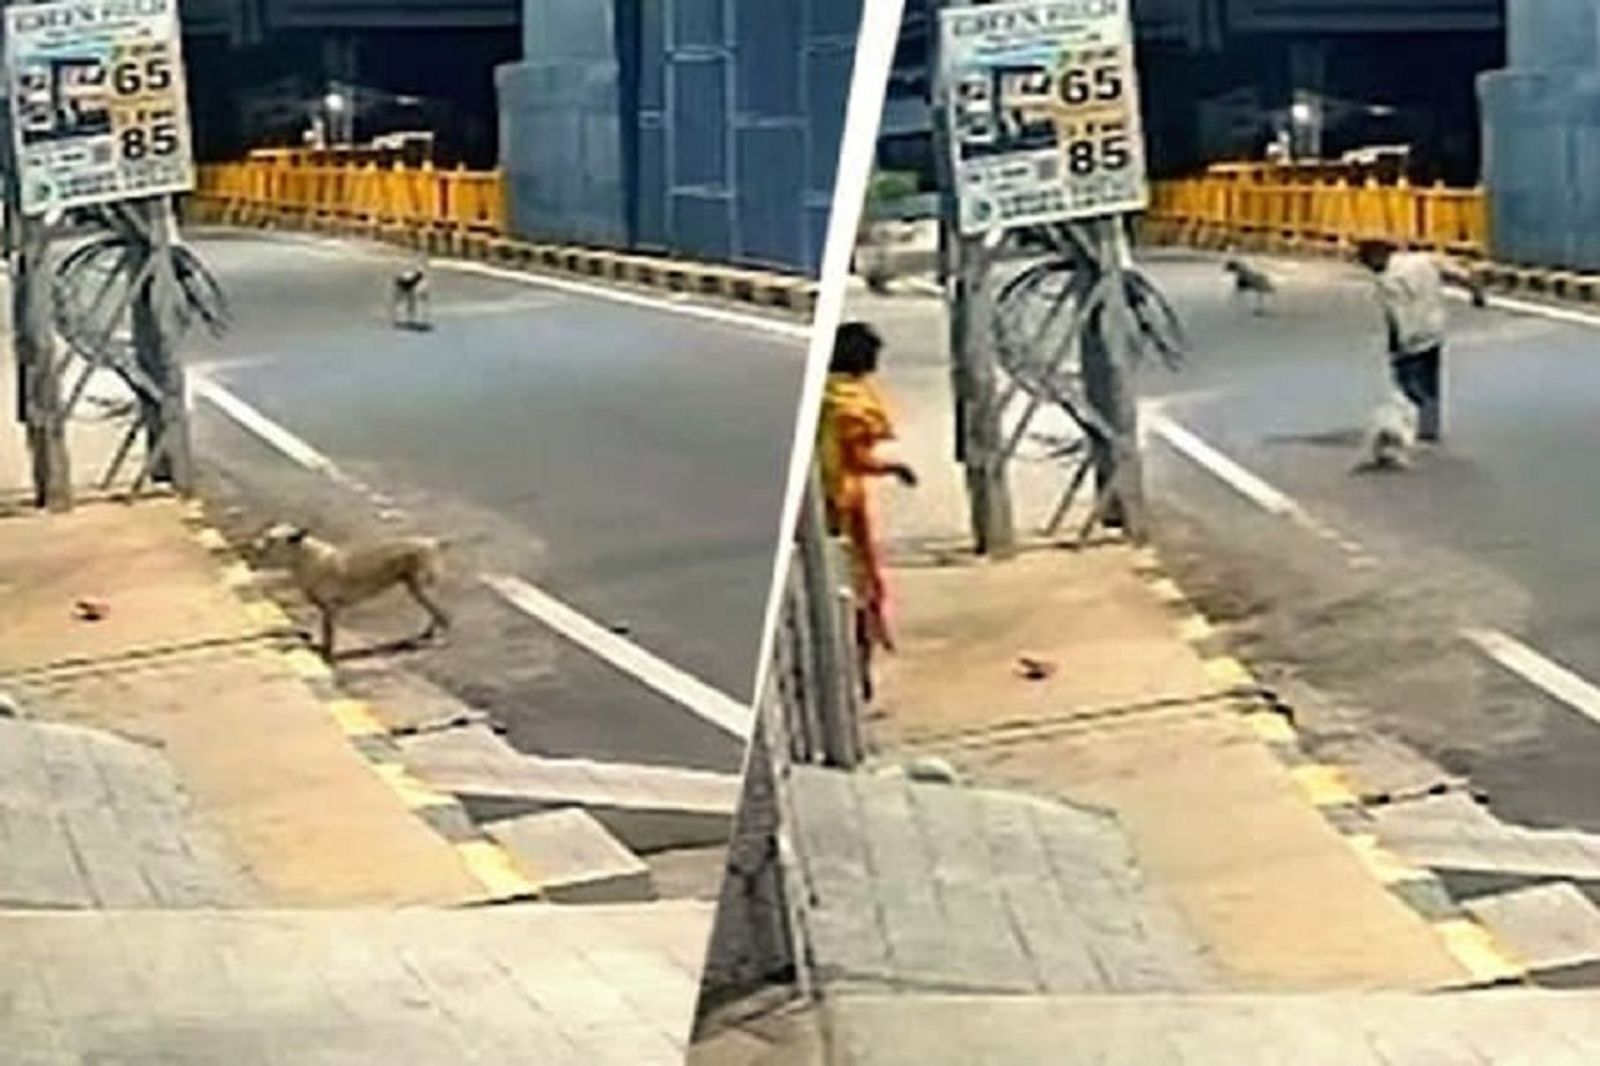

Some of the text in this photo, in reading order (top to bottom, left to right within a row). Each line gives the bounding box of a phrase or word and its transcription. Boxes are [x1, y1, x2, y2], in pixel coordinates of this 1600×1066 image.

[112, 58, 172, 95] 65
[1059, 66, 1123, 105] 65
[121, 124, 179, 160] 85
[1068, 136, 1130, 175] 85
